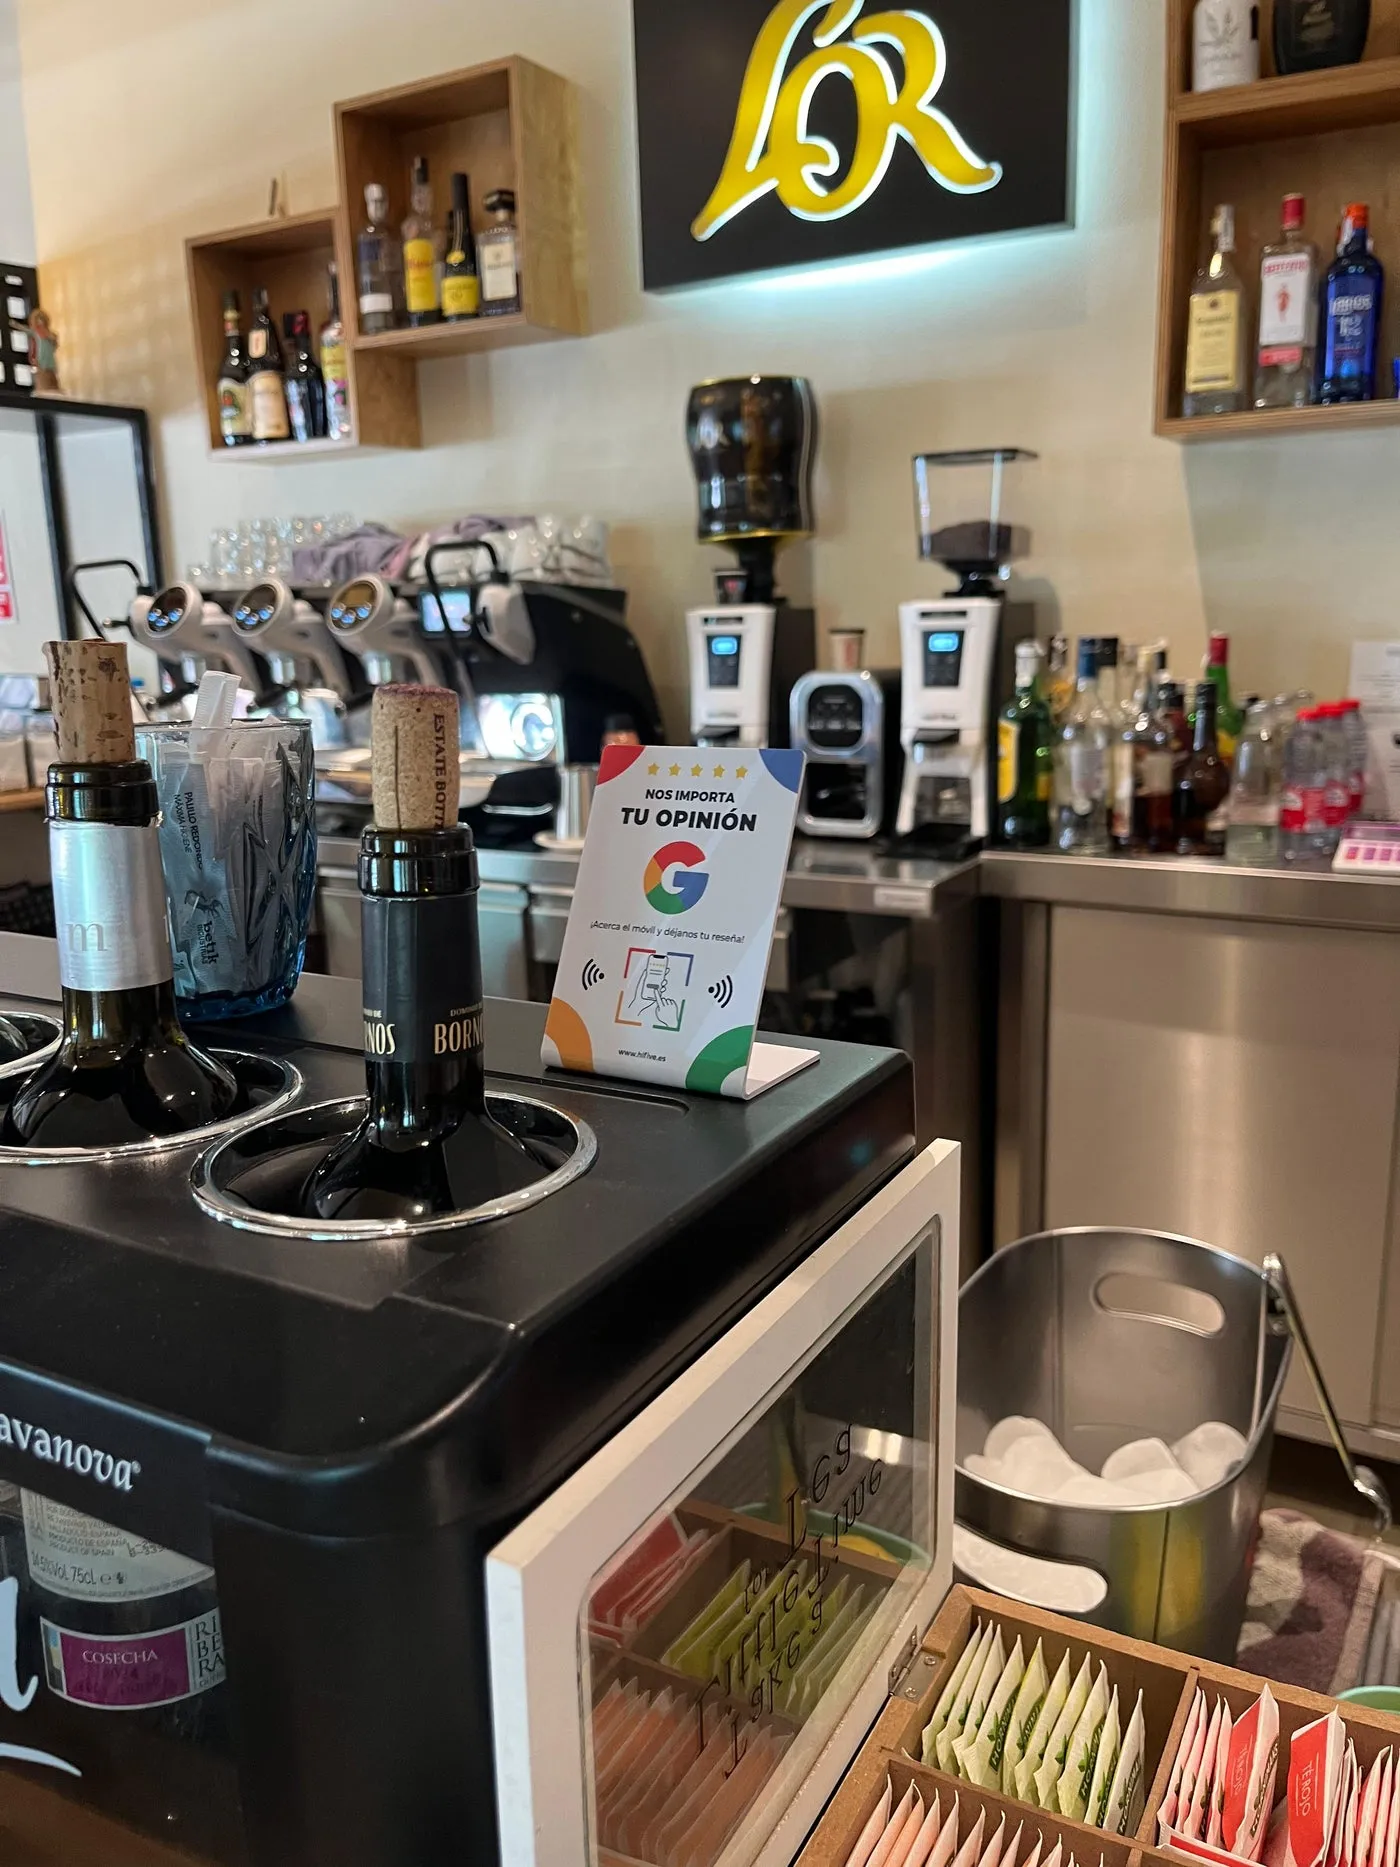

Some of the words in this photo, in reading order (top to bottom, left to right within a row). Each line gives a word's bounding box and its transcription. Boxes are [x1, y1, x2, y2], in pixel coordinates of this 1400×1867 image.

[433, 713, 446, 777] ESTATE
[645, 788, 673, 801] NOS
[674, 790, 735, 804] IMPORTA
[621, 807, 650, 826] TU
[655, 808, 757, 832] OPINIÓN
[643, 841, 710, 915] G
[65, 922, 108, 952] m
[589, 920, 621, 932] ¡Acerca
[622, 923, 631, 932] el
[632, 924, 656, 936] móvil
[656, 927, 663, 937] y
[664, 927, 698, 940] déjanos
[700, 931, 710, 941] tu
[711, 932, 745, 944] reseña!
[618, 1048, 667, 1062] www.hifive.es
[82, 1649, 159, 1665] COSECHA
[1300, 1759, 1313, 1781] TÉ
[1299, 1779, 1312, 1817] ROJO
